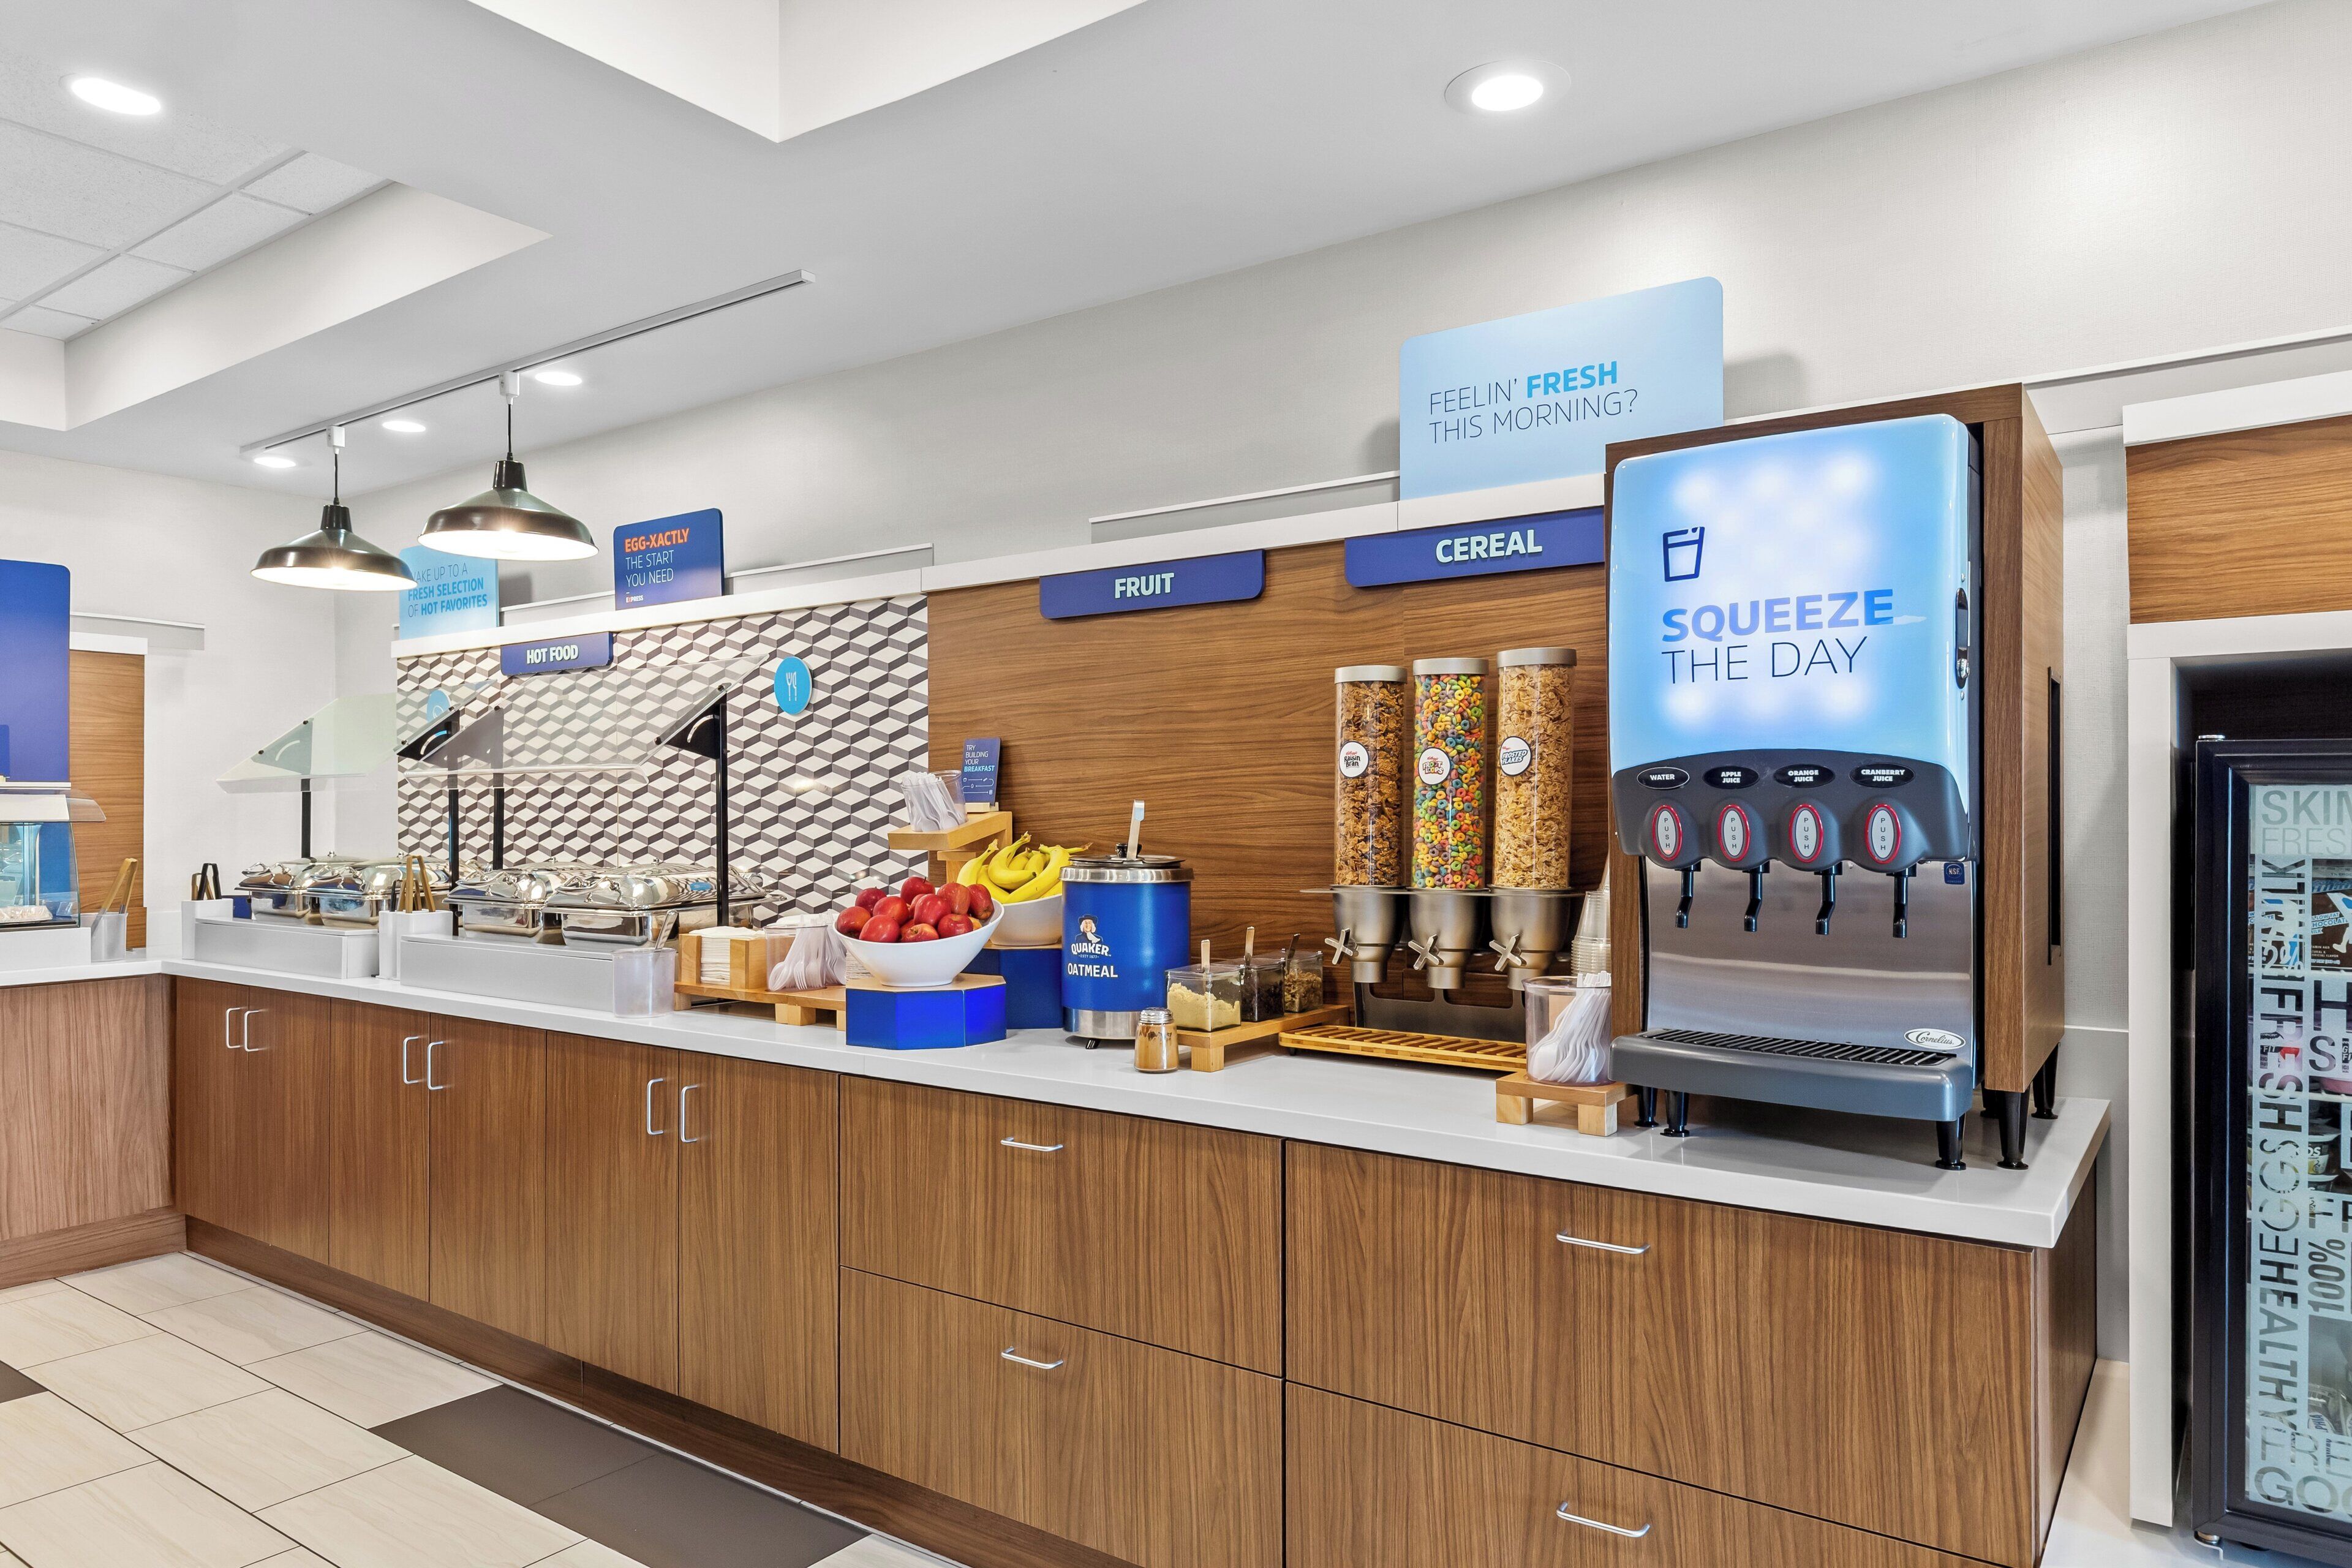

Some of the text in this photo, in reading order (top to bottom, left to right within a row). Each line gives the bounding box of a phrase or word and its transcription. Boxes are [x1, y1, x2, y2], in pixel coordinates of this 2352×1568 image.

[1430, 360, 1618, 415] FEELIN' FRESH
[1429, 389, 1638, 443] THIS MORNING?
[625, 528, 690, 552] EGG-XACTLY
[1436, 529, 1543, 564] CEREAL
[434, 566, 445, 581] UP
[448, 564, 459, 577] TO
[462, 562, 468, 576] A
[625, 549, 674, 570] THE START
[408, 577, 484, 601] FRESH SELECTION
[626, 568, 674, 587] YOU NEED
[1115, 572, 1175, 599] FRUIT
[408, 594, 488, 618] OF HOT FAVORITES
[625, 595, 644, 603] EXPRESS
[1662, 588, 1894, 643] SQUEEZE
[526, 644, 579, 665] HOT FOOD
[1662, 636, 1868, 684] THE DAY
[1502, 749, 1528, 760] FROSTED
[1502, 756, 1523, 765] FLAKES
[2262, 827, 2352, 856] FRES
[1071, 942, 1110, 957] QUAKER
[1068, 962, 1118, 978] OATMEAL
[1916, 1031, 1953, 1045] Cornelius
[2307, 1239, 2346, 1313] 100%
[2258, 1259, 2299, 1431] HEALTHY
